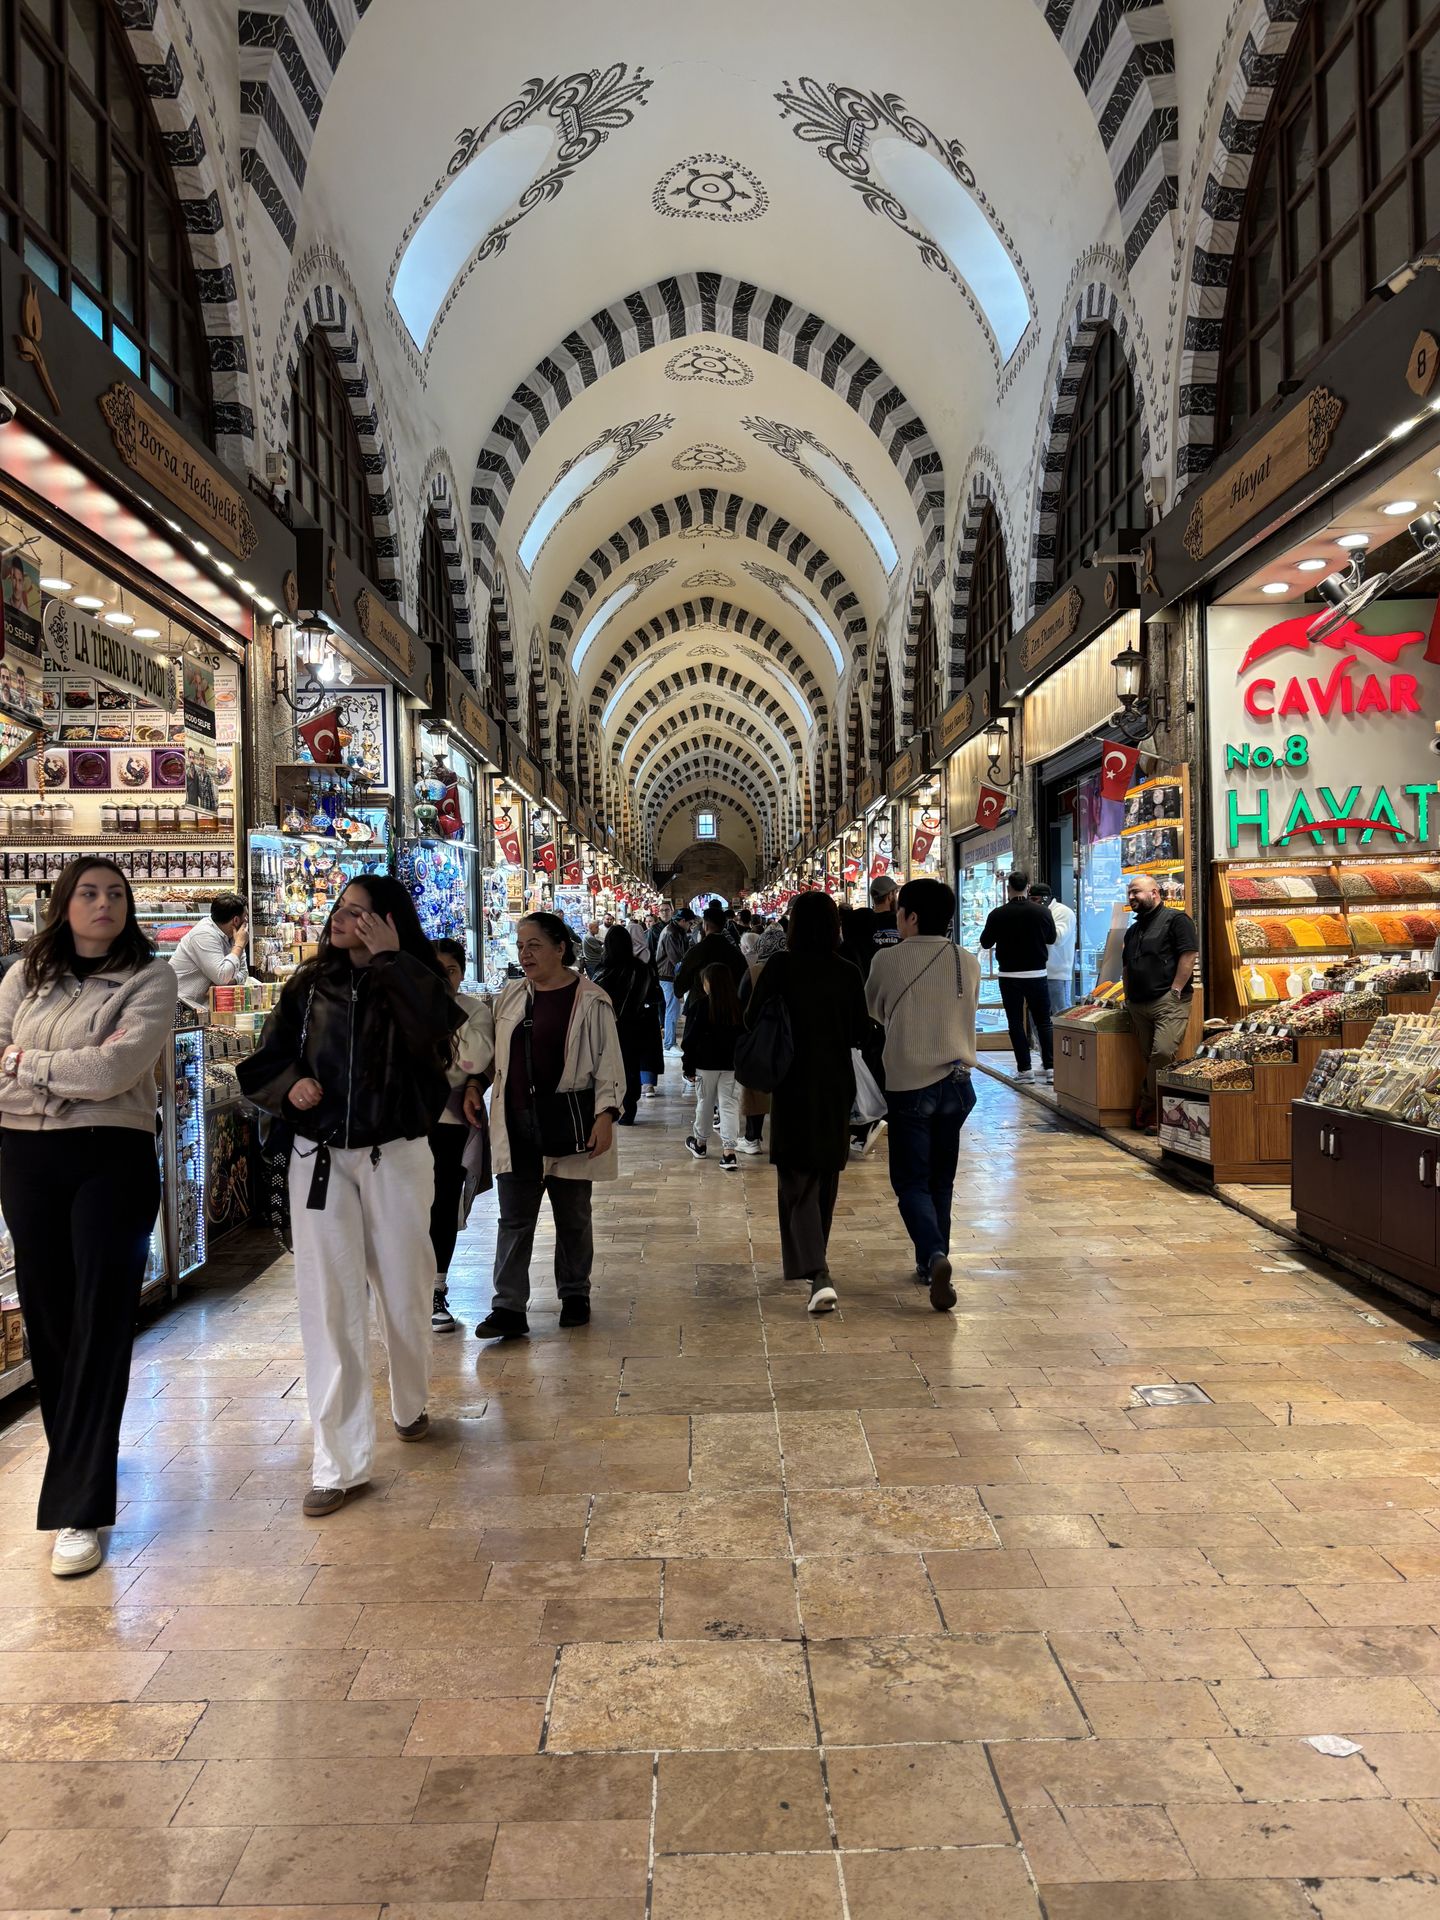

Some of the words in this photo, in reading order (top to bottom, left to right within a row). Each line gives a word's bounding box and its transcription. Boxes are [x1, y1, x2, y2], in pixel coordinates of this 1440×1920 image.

[1416, 348, 1426, 378] 8
[137, 421, 180, 476] Borsa
[181, 461, 238, 531] Hediyelik
[1229, 453, 1273, 509] Hayat
[14, 626, 35, 646] SELFIE
[73, 621, 90, 665] LA
[131, 649, 143, 688] DE
[1243, 654, 1422, 717] CAVIAR
[197, 717, 211, 729] SELFIE
[1225, 734, 1310, 770] No.8
[1225, 784, 1440, 849] HAYAT
